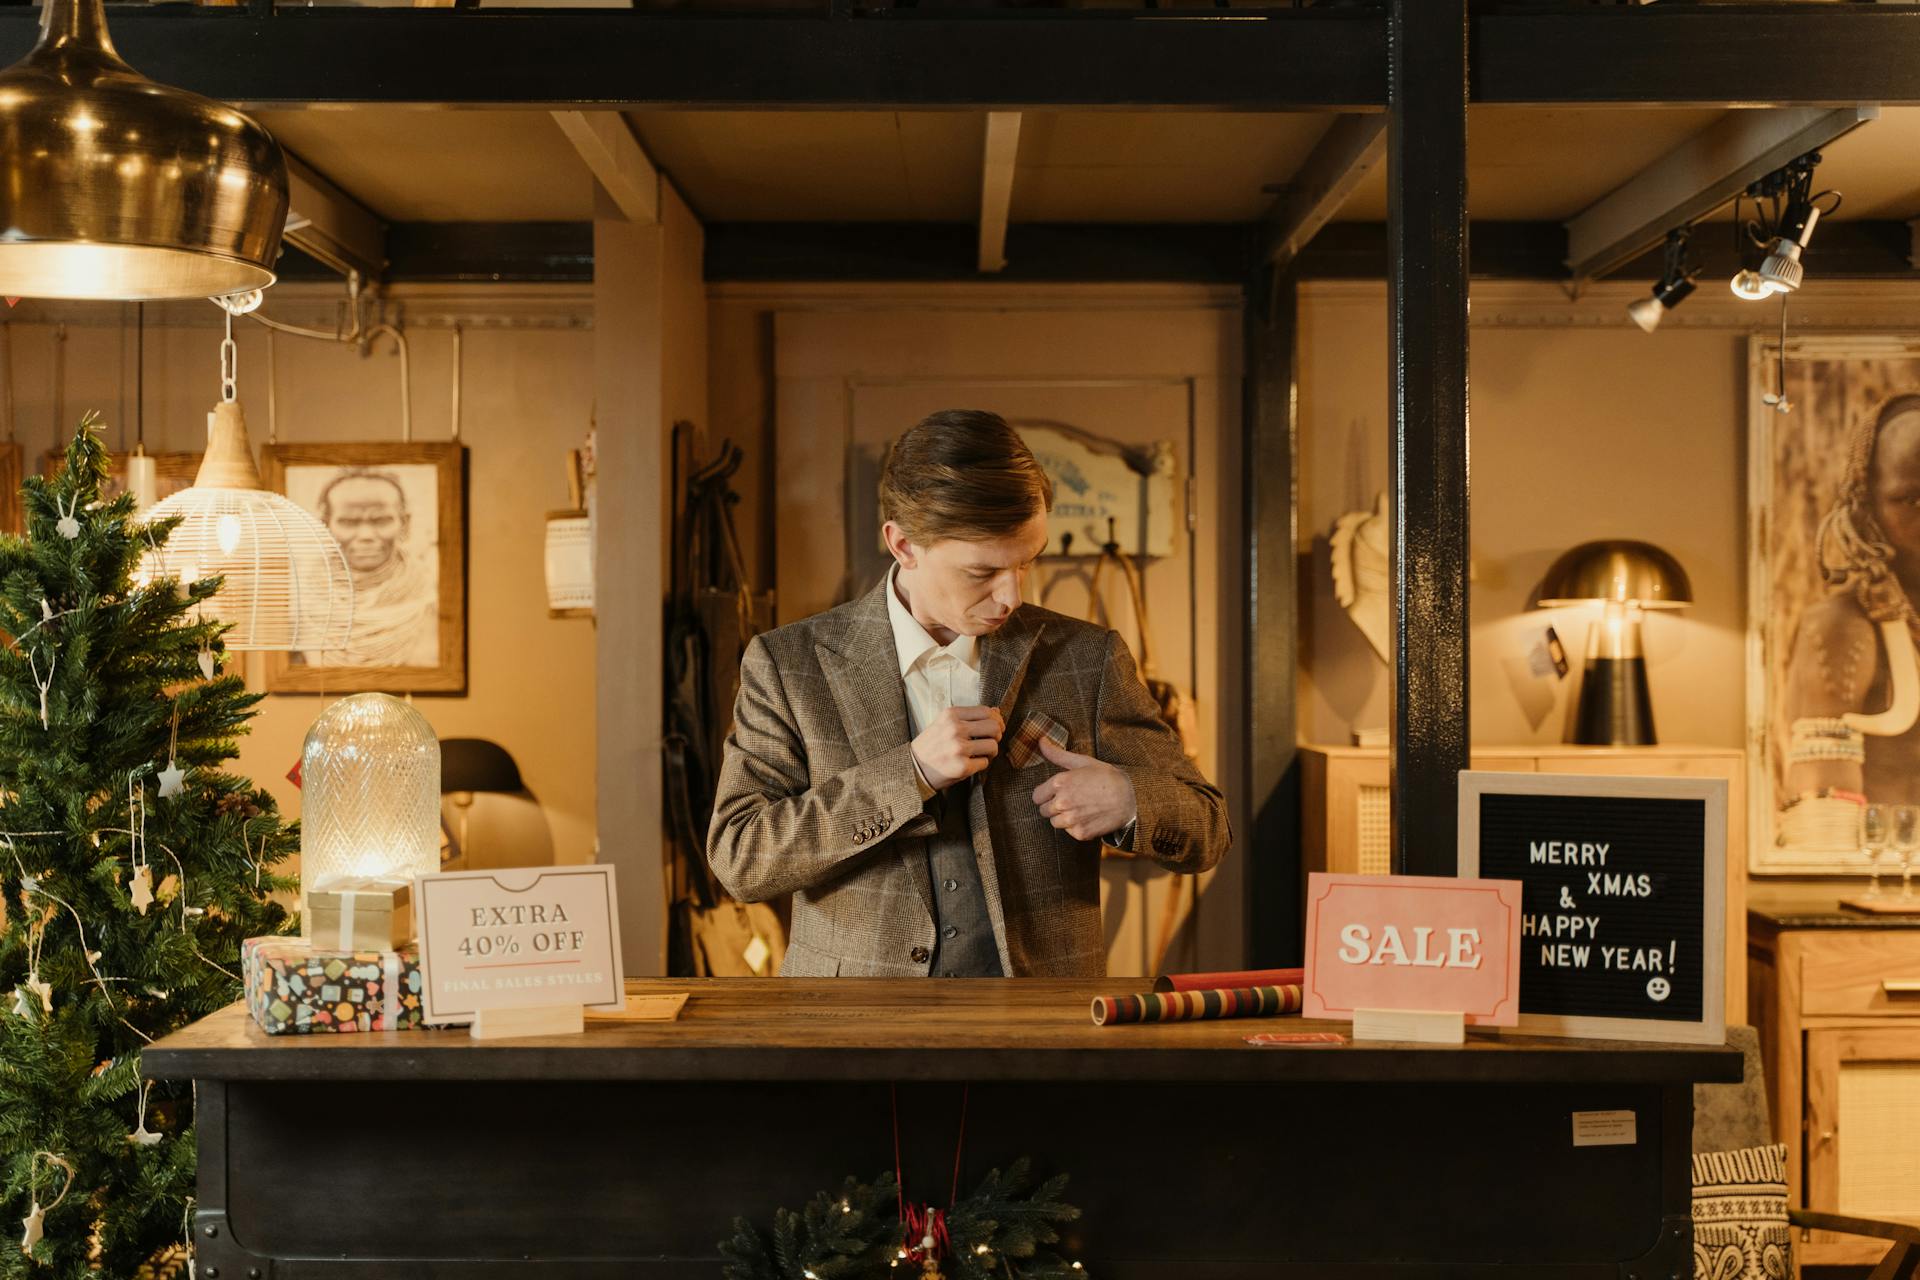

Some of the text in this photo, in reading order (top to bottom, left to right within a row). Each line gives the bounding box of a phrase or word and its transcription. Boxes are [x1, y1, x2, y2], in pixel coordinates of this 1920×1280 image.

[1530, 841, 1610, 866] MERRY
[1560, 885, 1576, 908] &
[1587, 872, 1652, 897] XMAS
[471, 904, 568, 926] EXTRA
[1522, 914, 1600, 939] HAPPY
[458, 931, 585, 956] 40% OFF
[1339, 924, 1482, 969] SALE
[1541, 940, 1676, 974] NEW YEAR!
[445, 972, 602, 992] FINAL SALES STYLES
